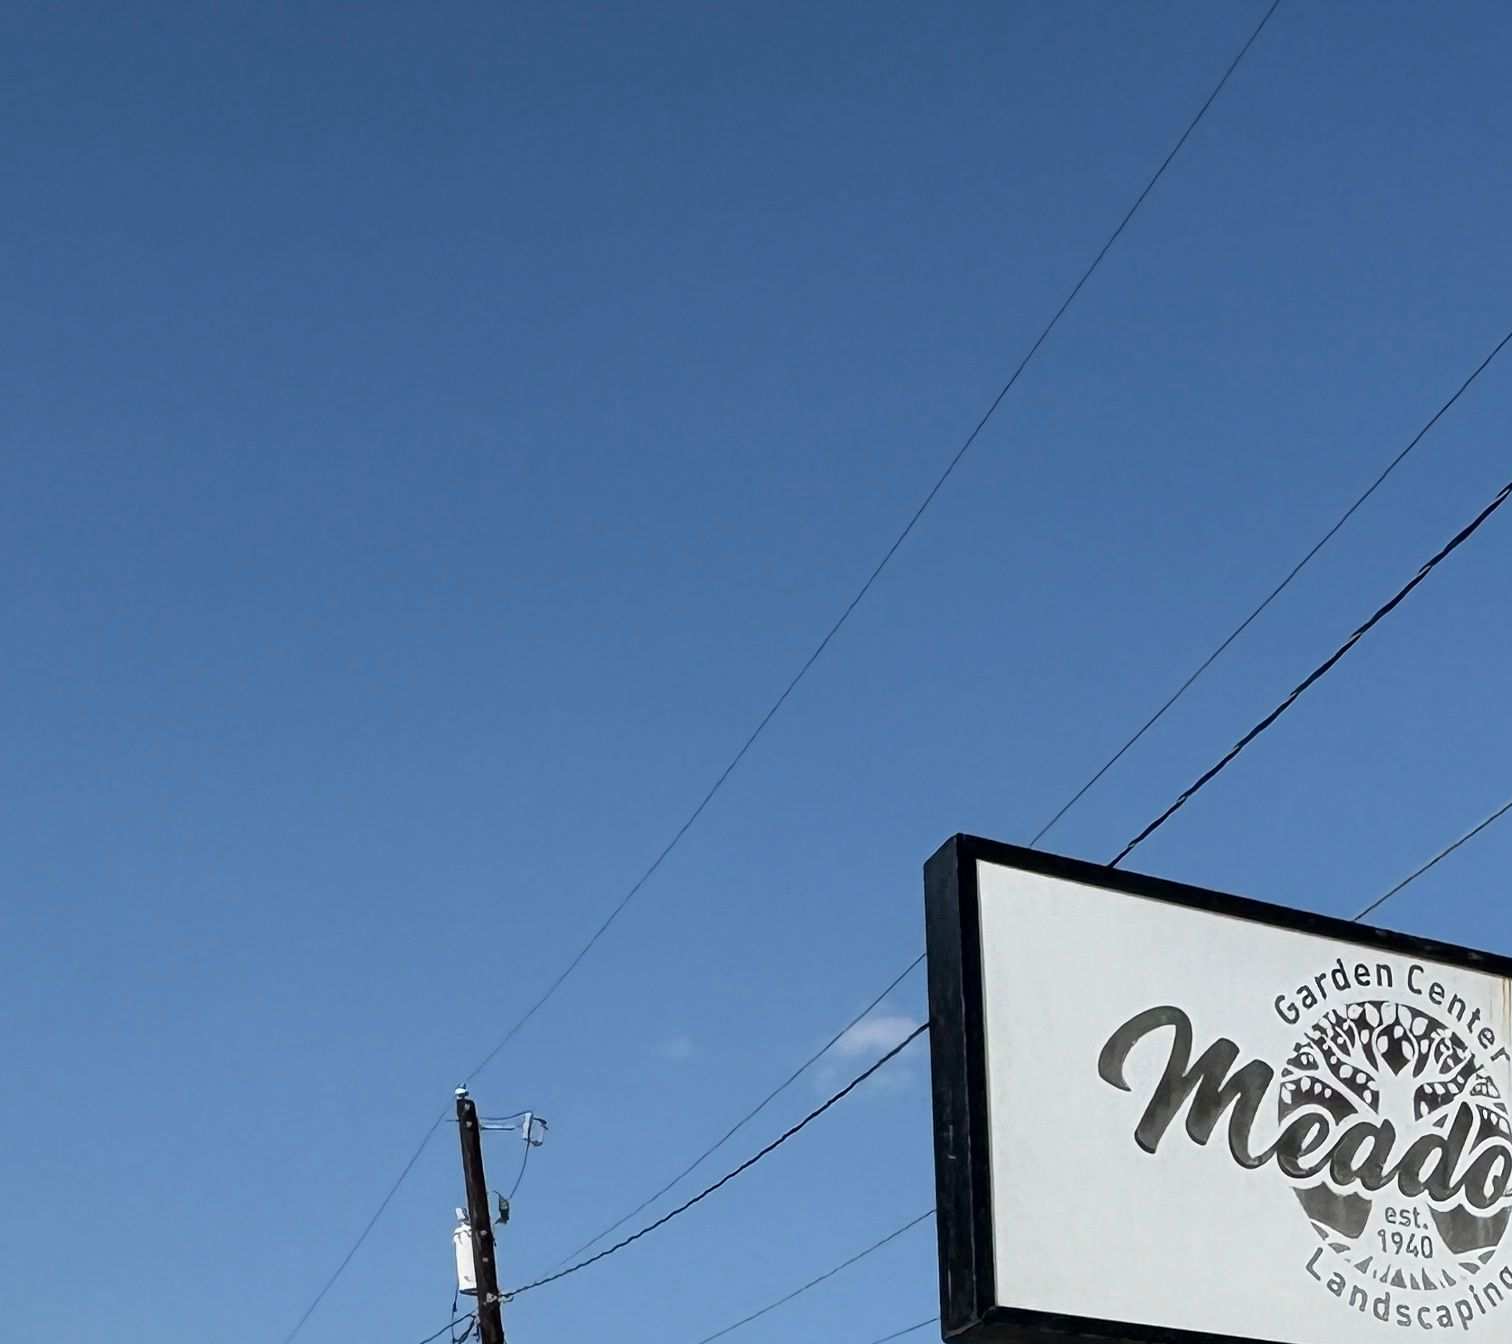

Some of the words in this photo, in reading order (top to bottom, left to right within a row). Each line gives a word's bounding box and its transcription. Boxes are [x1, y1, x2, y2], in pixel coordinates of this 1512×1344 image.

[1274, 957, 1394, 1025] Garden
[1408, 963, 1512, 1065] Center
[1383, 1204, 1431, 1230] est.
[1376, 1228, 1434, 1261] 1940
